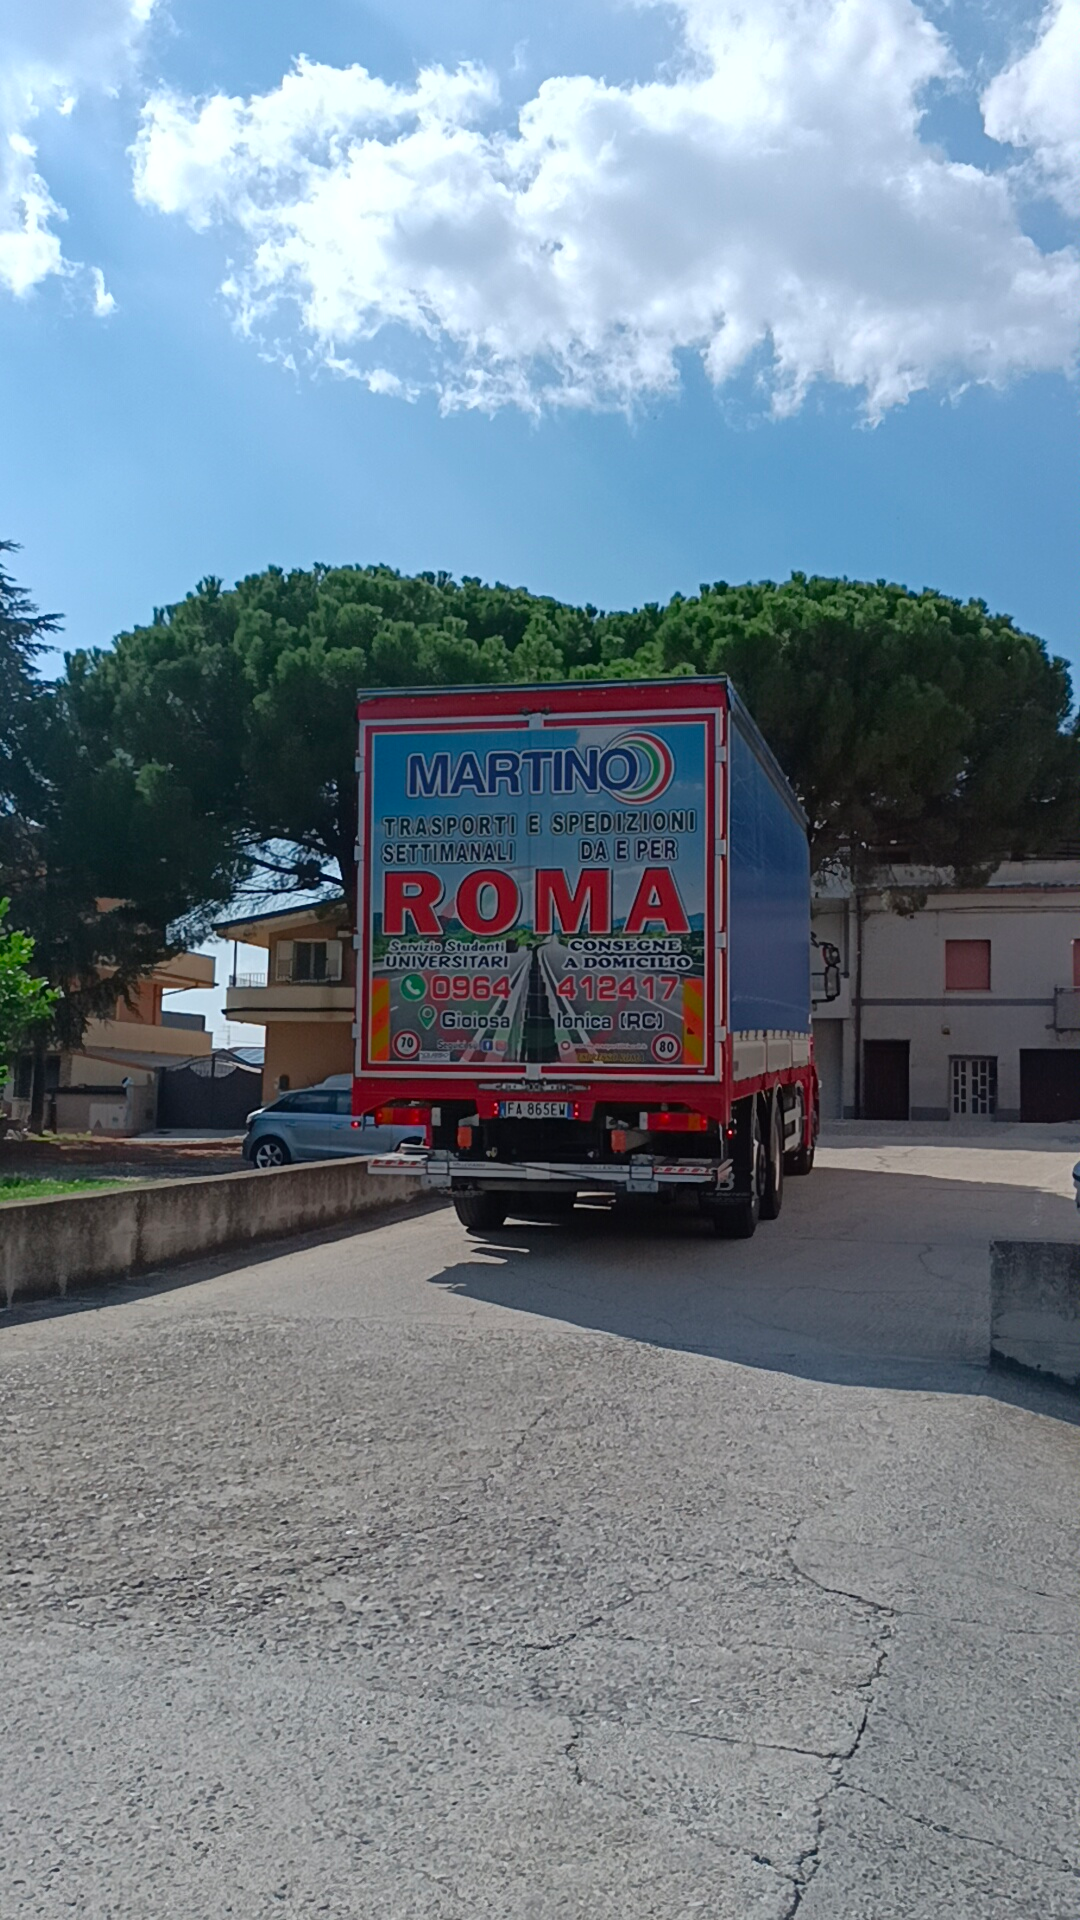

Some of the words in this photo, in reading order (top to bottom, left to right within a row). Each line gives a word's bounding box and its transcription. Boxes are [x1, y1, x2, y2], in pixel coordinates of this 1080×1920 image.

[407, 748, 639, 798] MARTINO
[382, 814, 517, 838] TRASPORTI
[526, 813, 541, 835] E
[550, 809, 697, 834] SPEDIZIONI
[381, 840, 516, 864] SETTIMANALI
[578, 839, 609, 862] DA
[614, 839, 628, 862] E
[634, 837, 678, 861] PER
[382, 867, 691, 936] ROMA
[389, 940, 443, 953] Servizio
[445, 940, 506, 953] Studenti
[569, 939, 682, 953] CONSEGNE
[385, 955, 509, 969] UNIVERSITARI
[563, 955, 578, 969] A
[583, 955, 692, 970] DOMICILIO
[431, 975, 511, 1001] 0964
[557, 975, 679, 1001] 412417
[441, 1011, 510, 1029] Gioiosa
[557, 1011, 612, 1029] Ionica
[619, 1011, 664, 1029] (RC)
[400, 1036, 414, 1048] 70
[659, 1040, 675, 1053] 80
[507, 1102, 523, 1116] FA
[526, 1102, 566, 1117] 865EW
